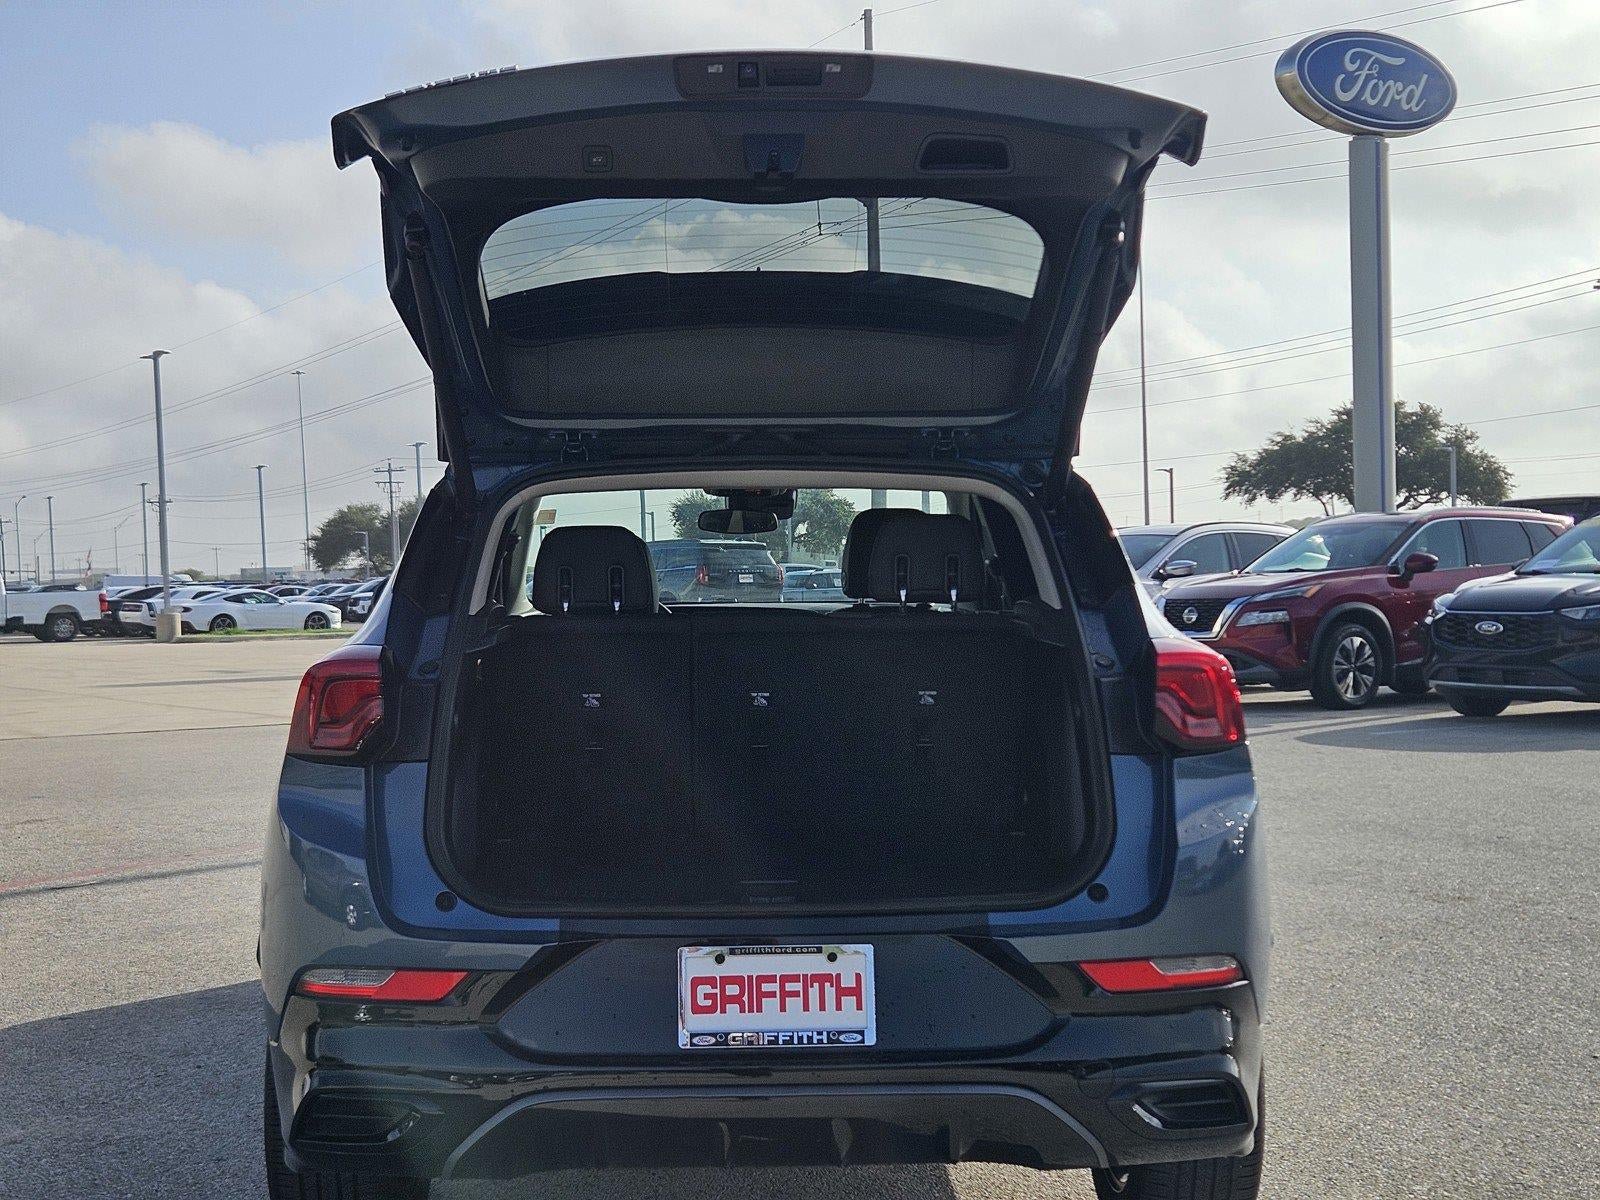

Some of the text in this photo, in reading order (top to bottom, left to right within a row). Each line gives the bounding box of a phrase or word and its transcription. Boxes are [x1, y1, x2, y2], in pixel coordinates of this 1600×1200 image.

[1335, 47, 1428, 112] Ford
[735, 946, 817, 955] griffithford.com
[690, 973, 864, 1015] GRIFFITH
[728, 1031, 827, 1046] GRIFFITH
